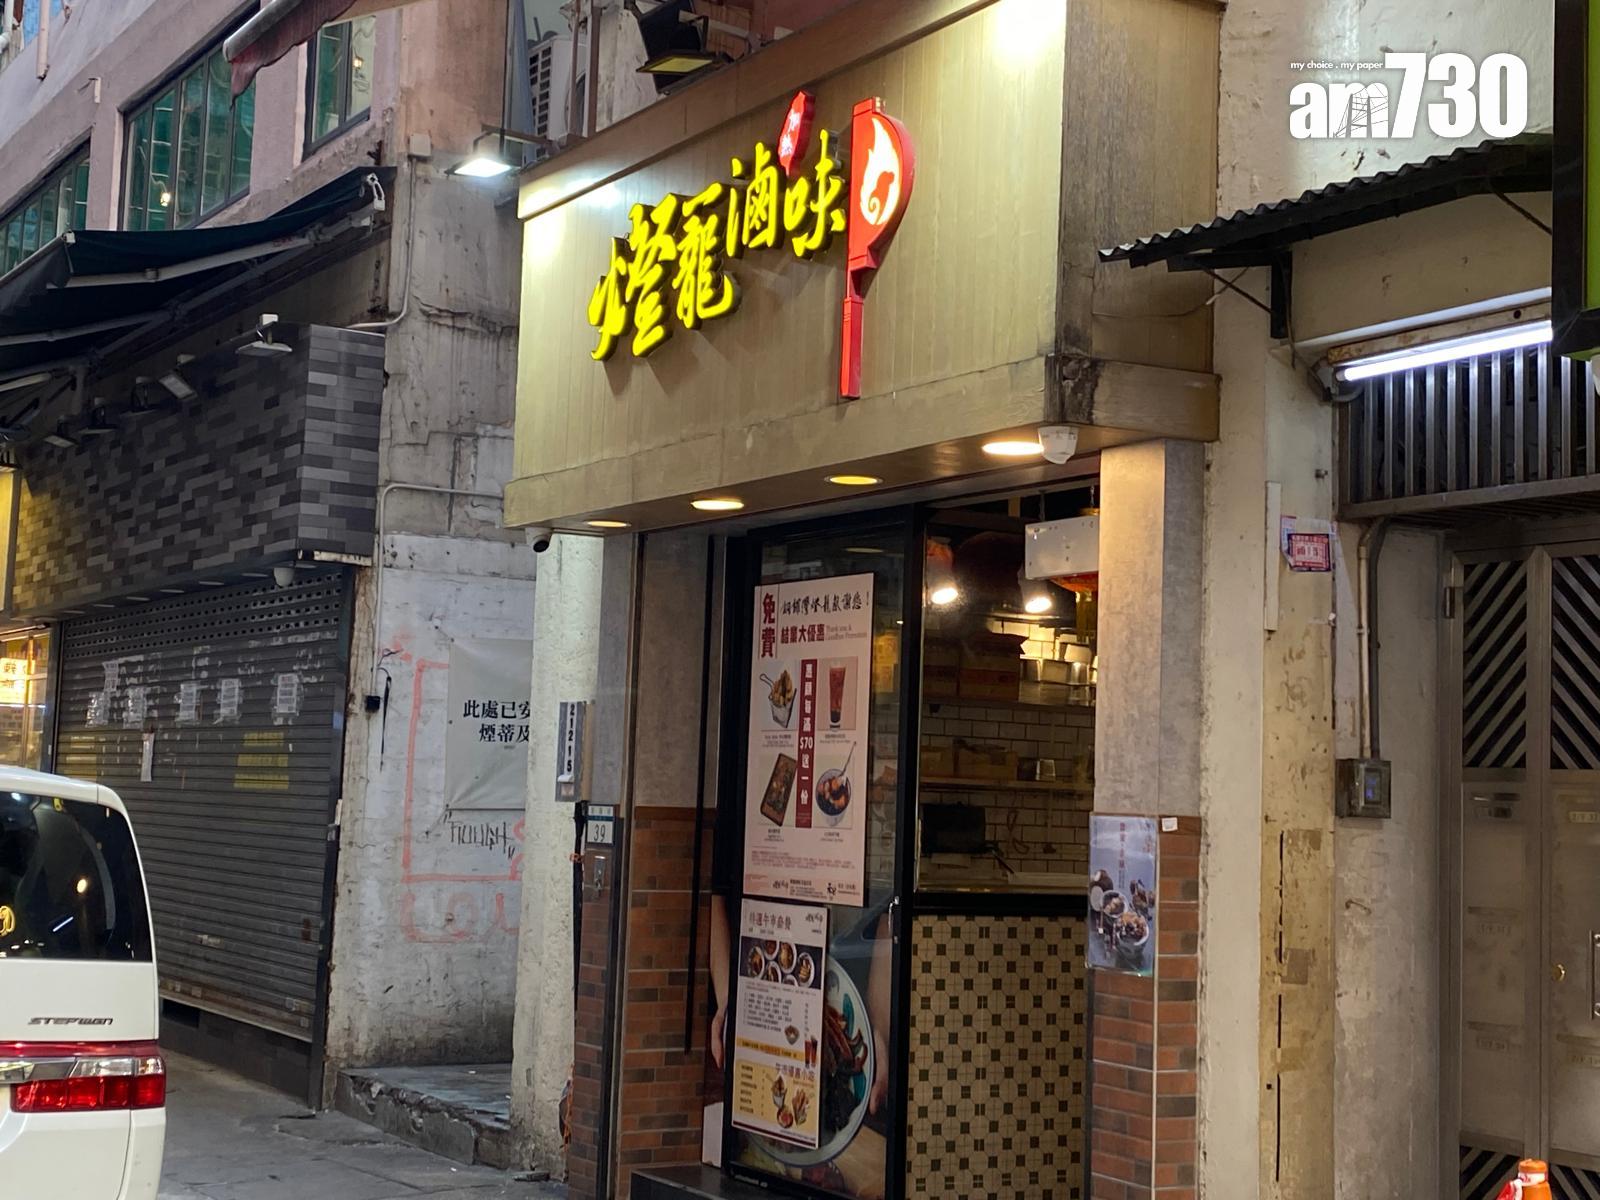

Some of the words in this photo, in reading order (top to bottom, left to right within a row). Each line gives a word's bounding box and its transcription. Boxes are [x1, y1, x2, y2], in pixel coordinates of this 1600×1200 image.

[760, 592, 776, 658] 免費
[780, 623, 825, 645] 結業大優惠
[478, 723, 530, 743] 煙蒂及
[593, 824, 606, 842] 39
